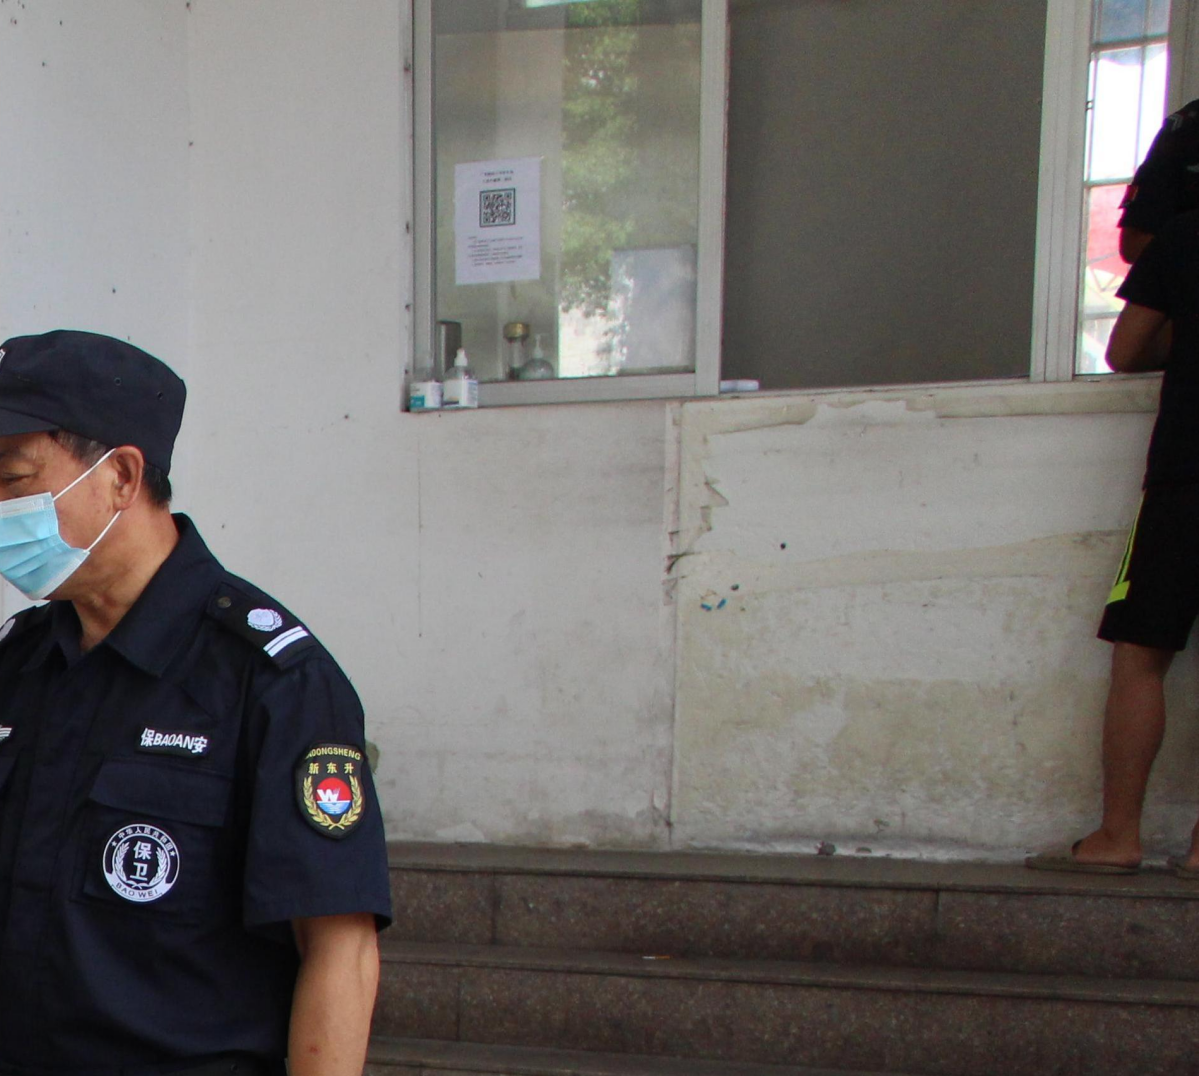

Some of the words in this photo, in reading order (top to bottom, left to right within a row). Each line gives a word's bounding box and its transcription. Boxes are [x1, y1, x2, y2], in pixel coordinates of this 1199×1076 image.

[308, 762, 354, 775] 新东升
[129, 840, 152, 881] 保卫
